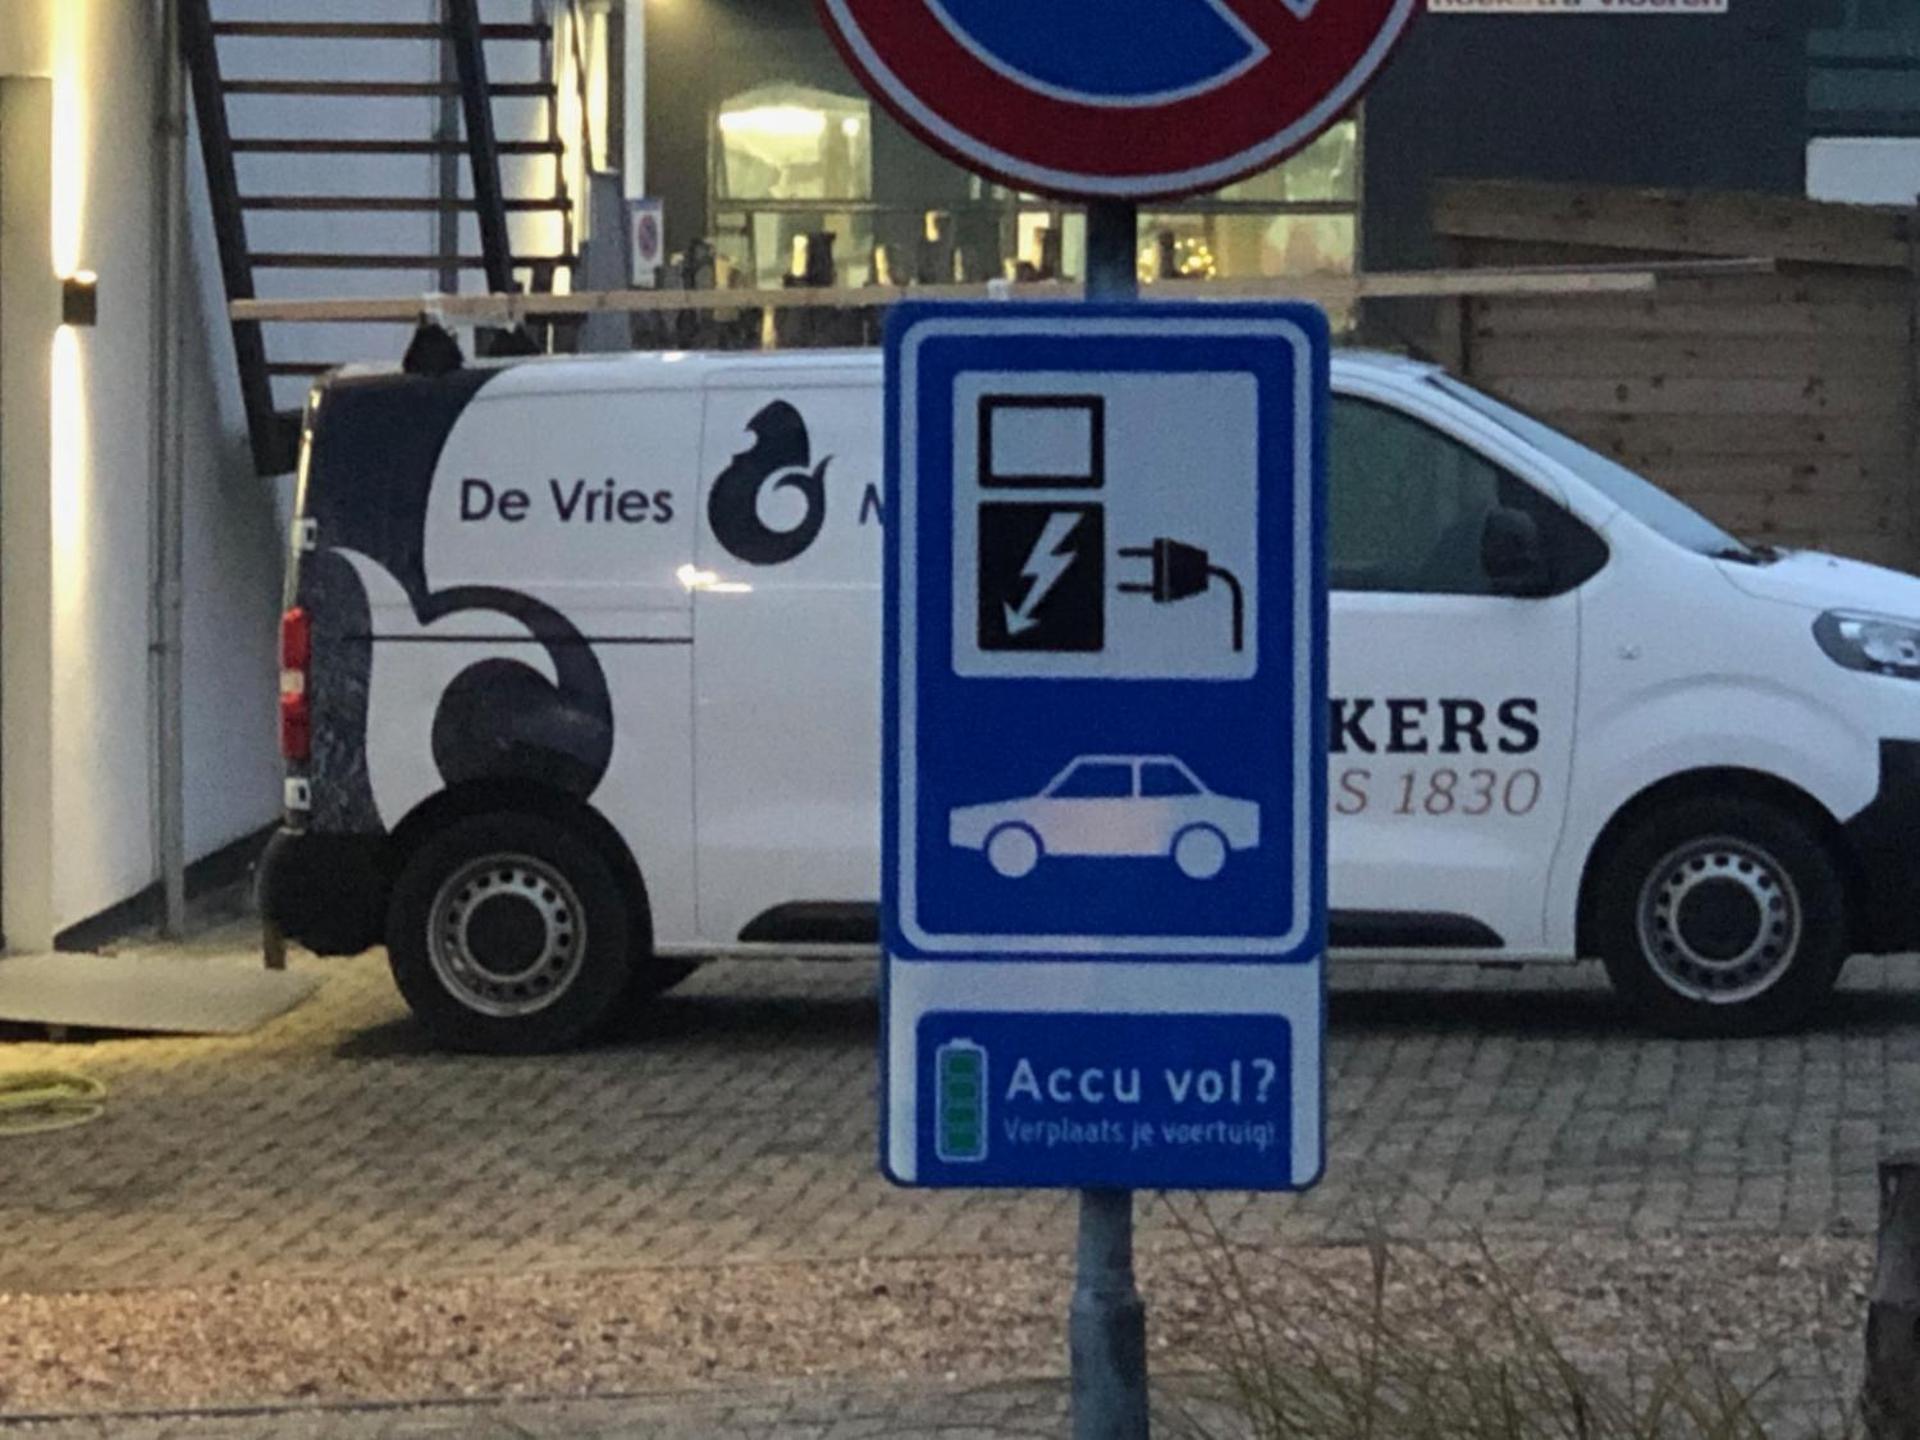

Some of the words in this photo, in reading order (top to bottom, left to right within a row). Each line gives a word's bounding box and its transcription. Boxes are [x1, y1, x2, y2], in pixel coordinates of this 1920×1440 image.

[460, 478, 531, 523] De
[549, 478, 674, 524] Vries
[1329, 697, 1540, 755] KERS
[1392, 766, 1542, 816] 1830
[1005, 1058, 1140, 1102] Accu
[1165, 1058, 1277, 1104] vol?
[1004, 1118, 1124, 1147] Verplaats
[1131, 1118, 1155, 1150] je
